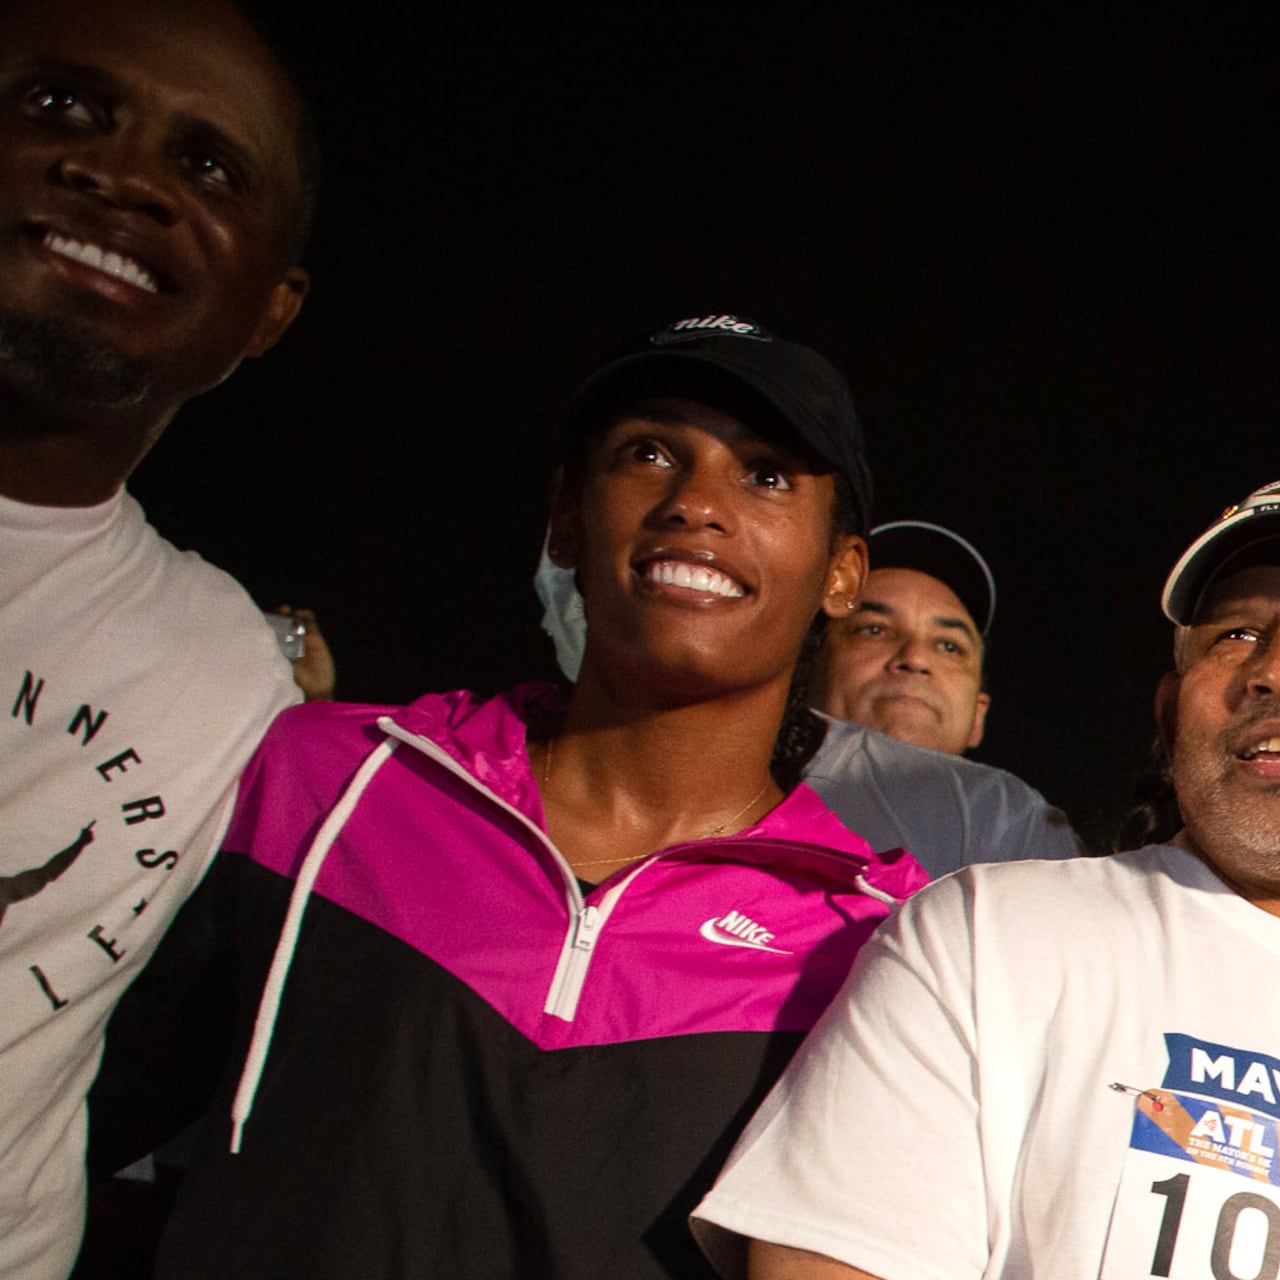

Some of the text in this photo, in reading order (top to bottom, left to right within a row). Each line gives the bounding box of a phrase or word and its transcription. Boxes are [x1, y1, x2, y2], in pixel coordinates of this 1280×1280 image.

[674, 315, 755, 333] nike
[716, 910, 775, 944] NIKE
[1190, 1110, 1274, 1158] ATL
